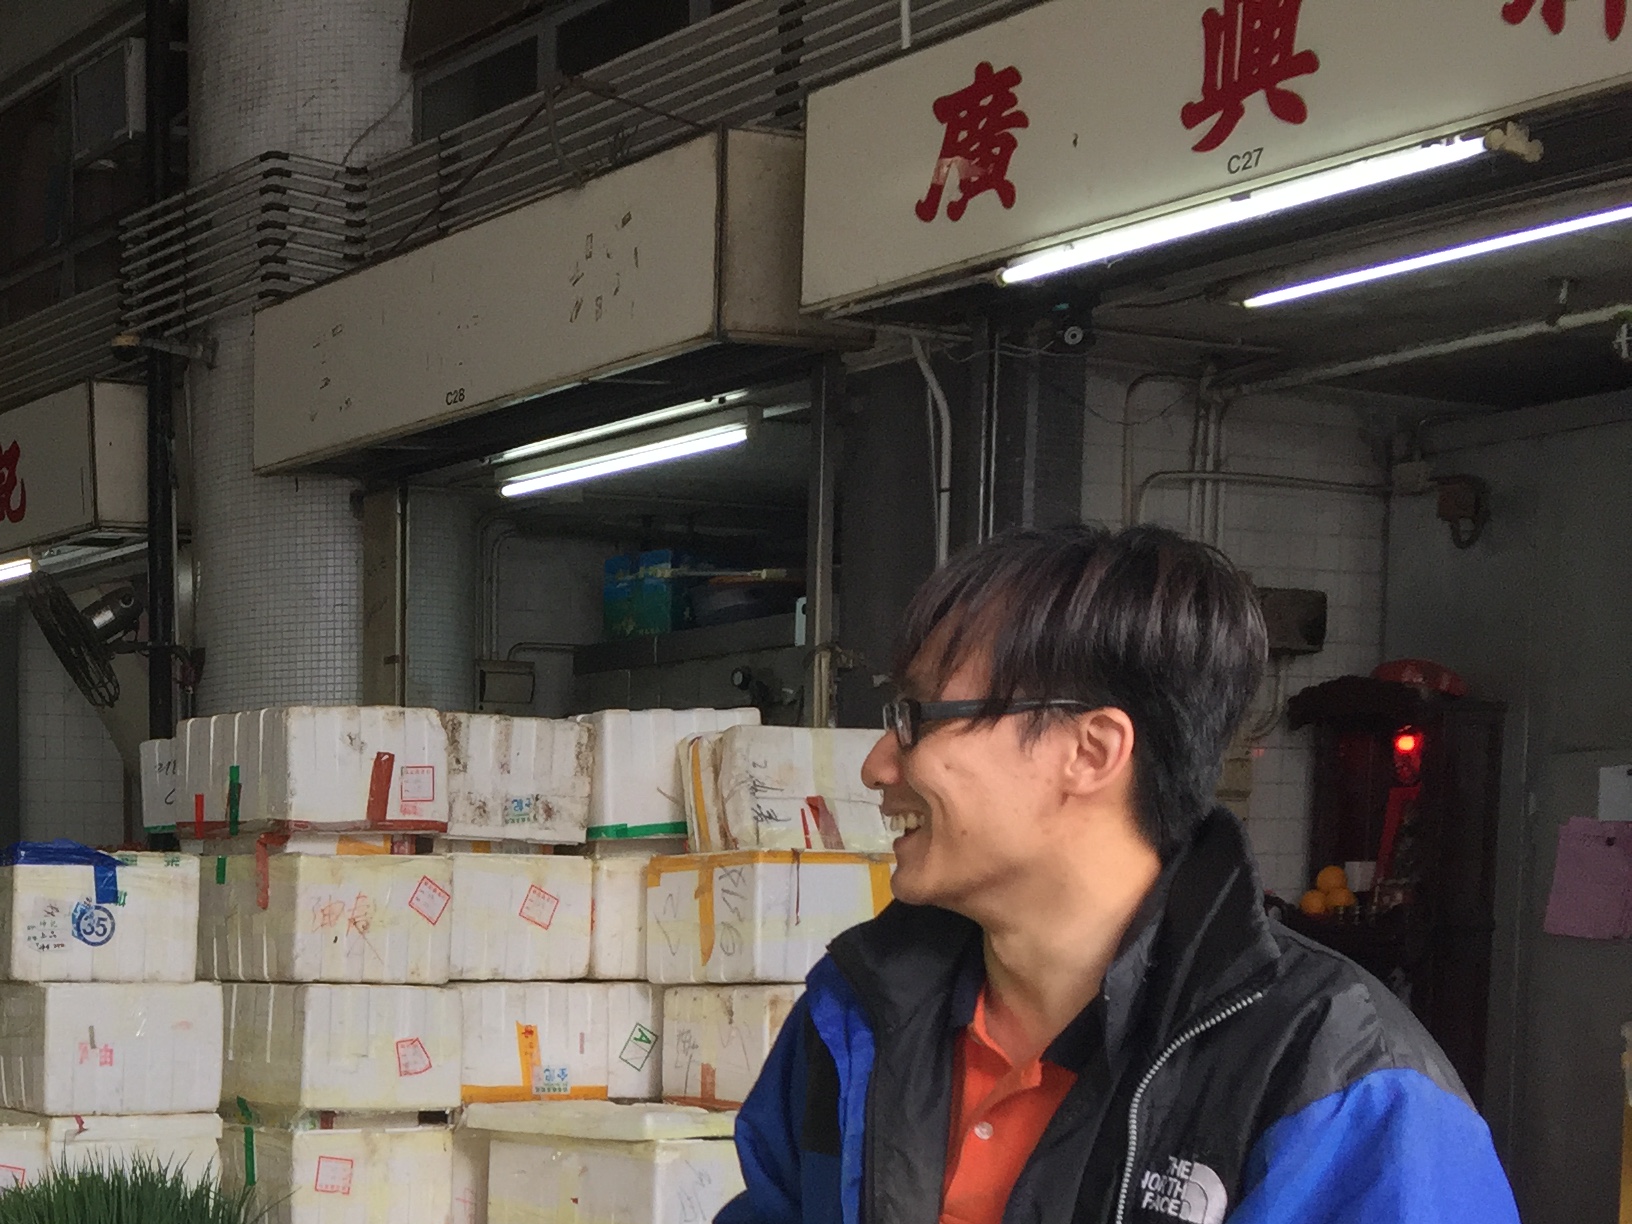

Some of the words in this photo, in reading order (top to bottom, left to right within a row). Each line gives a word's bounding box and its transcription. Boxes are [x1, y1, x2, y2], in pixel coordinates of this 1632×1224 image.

[914, 0, 1632, 222] 廣興
[1226, 147, 1265, 176] C27
[444, 387, 466, 406] C28
[82, 916, 108, 937] 35
[633, 1027, 652, 1045] A
[1168, 1154, 1194, 1180] THE
[1141, 1169, 1188, 1200] NORTH
[1141, 1190, 1183, 1217] FACE
